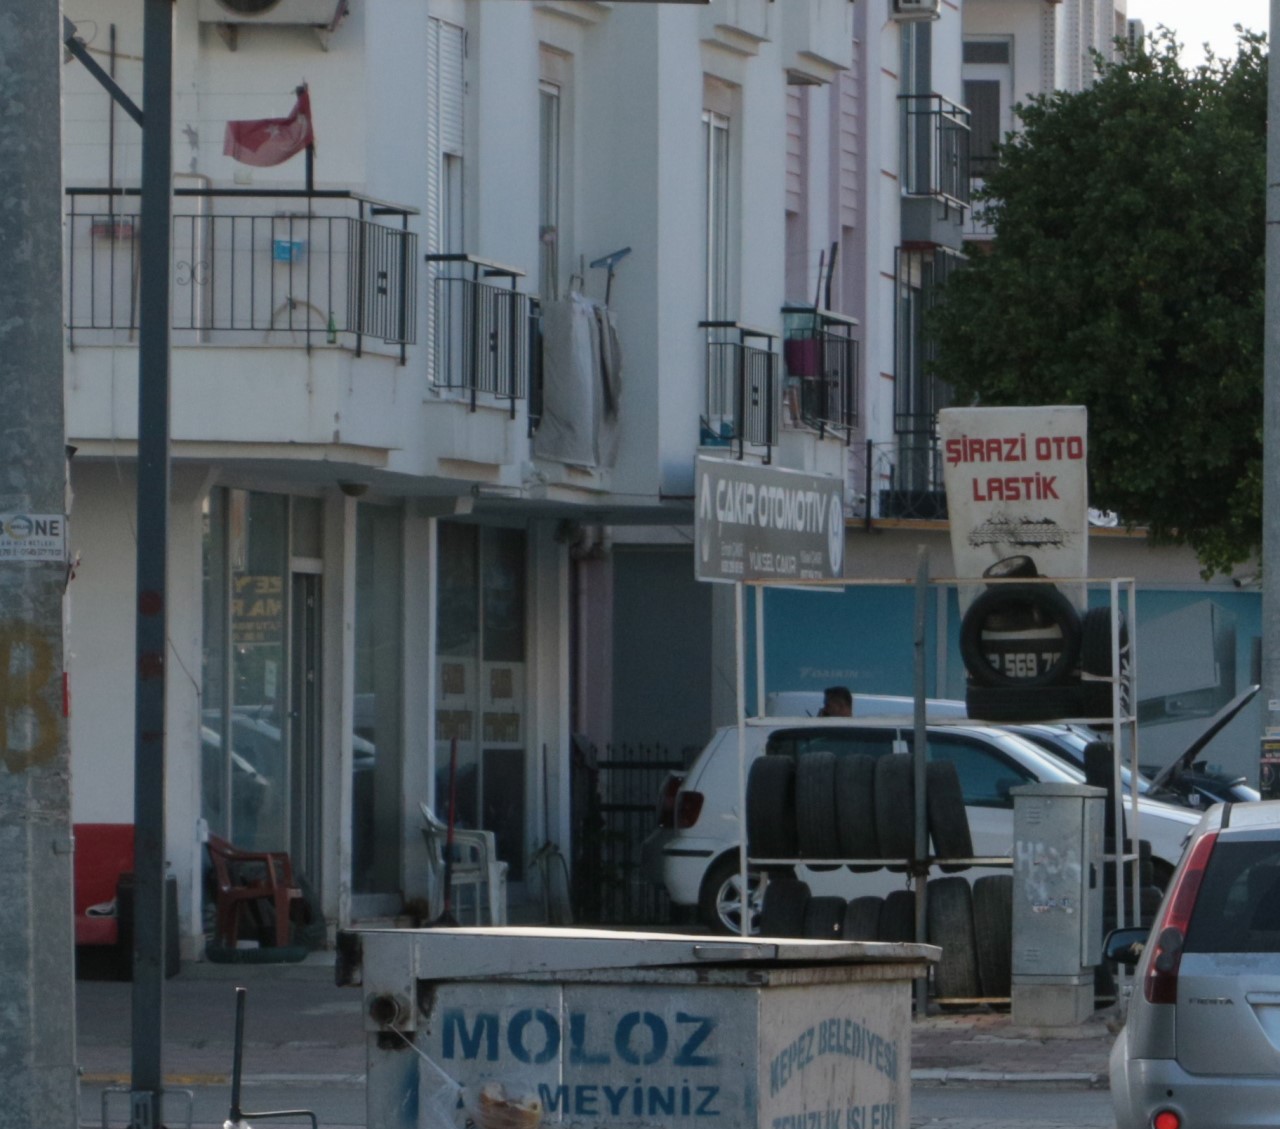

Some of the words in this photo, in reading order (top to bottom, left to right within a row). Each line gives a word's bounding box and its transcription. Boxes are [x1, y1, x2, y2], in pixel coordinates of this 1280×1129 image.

[945, 432, 1027, 467] ŞİRAZİ
[1035, 435, 1083, 461] OTO
[716, 478, 756, 537] ÇAKIR
[758, 481, 827, 534] OTOMOTİV
[972, 471, 1060, 502] LASTİK
[441, 1006, 721, 1067] MOLOZ
[770, 1026, 816, 1099] KEPEZ
[817, 1017, 897, 1082] BELEDİYESİ
